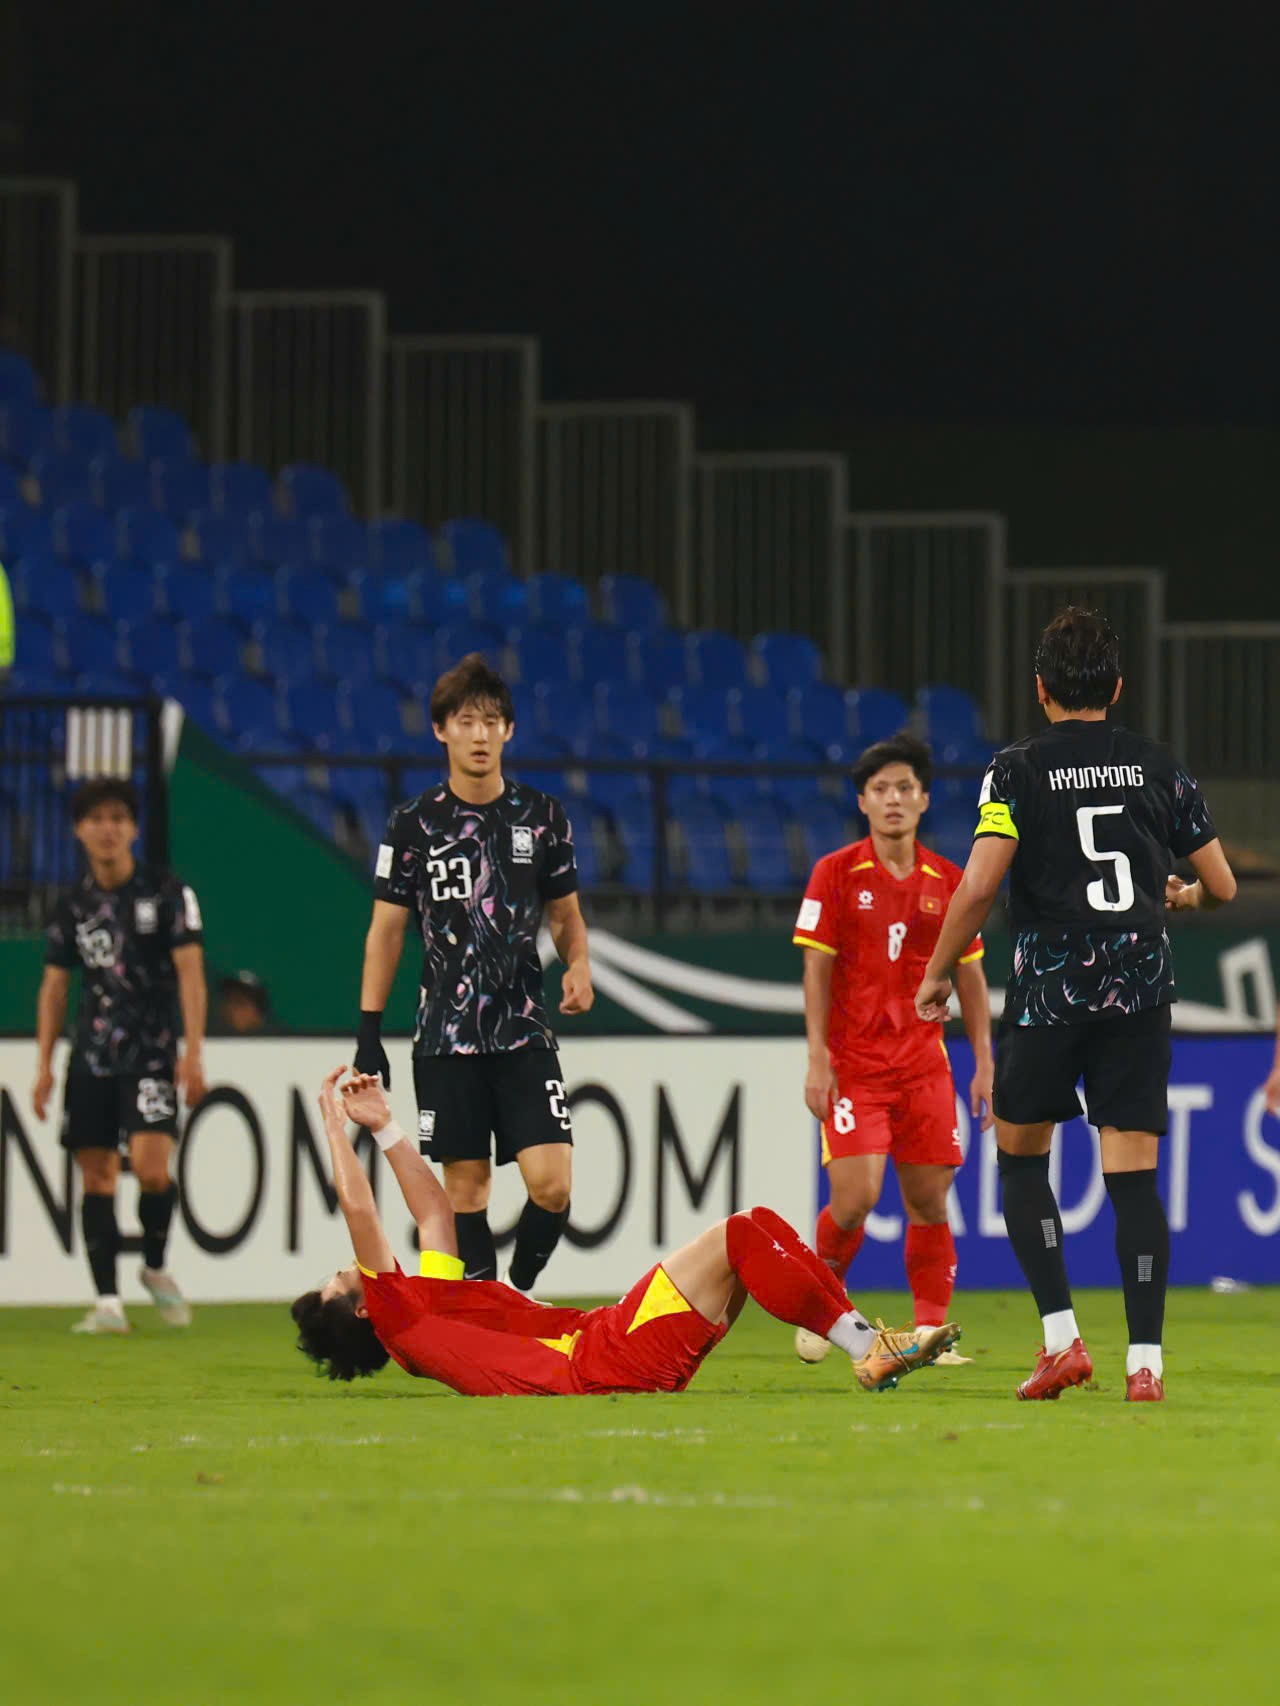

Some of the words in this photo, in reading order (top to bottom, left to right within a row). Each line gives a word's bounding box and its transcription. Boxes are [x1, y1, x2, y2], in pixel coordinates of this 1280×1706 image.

[1048, 764, 1145, 791] HYUNYONG
[1076, 804, 1135, 912] 5
[427, 856, 473, 902] 23
[888, 921, 908, 963] 8
[545, 1079, 569, 1119] 2
[833, 1096, 857, 1135] 8
